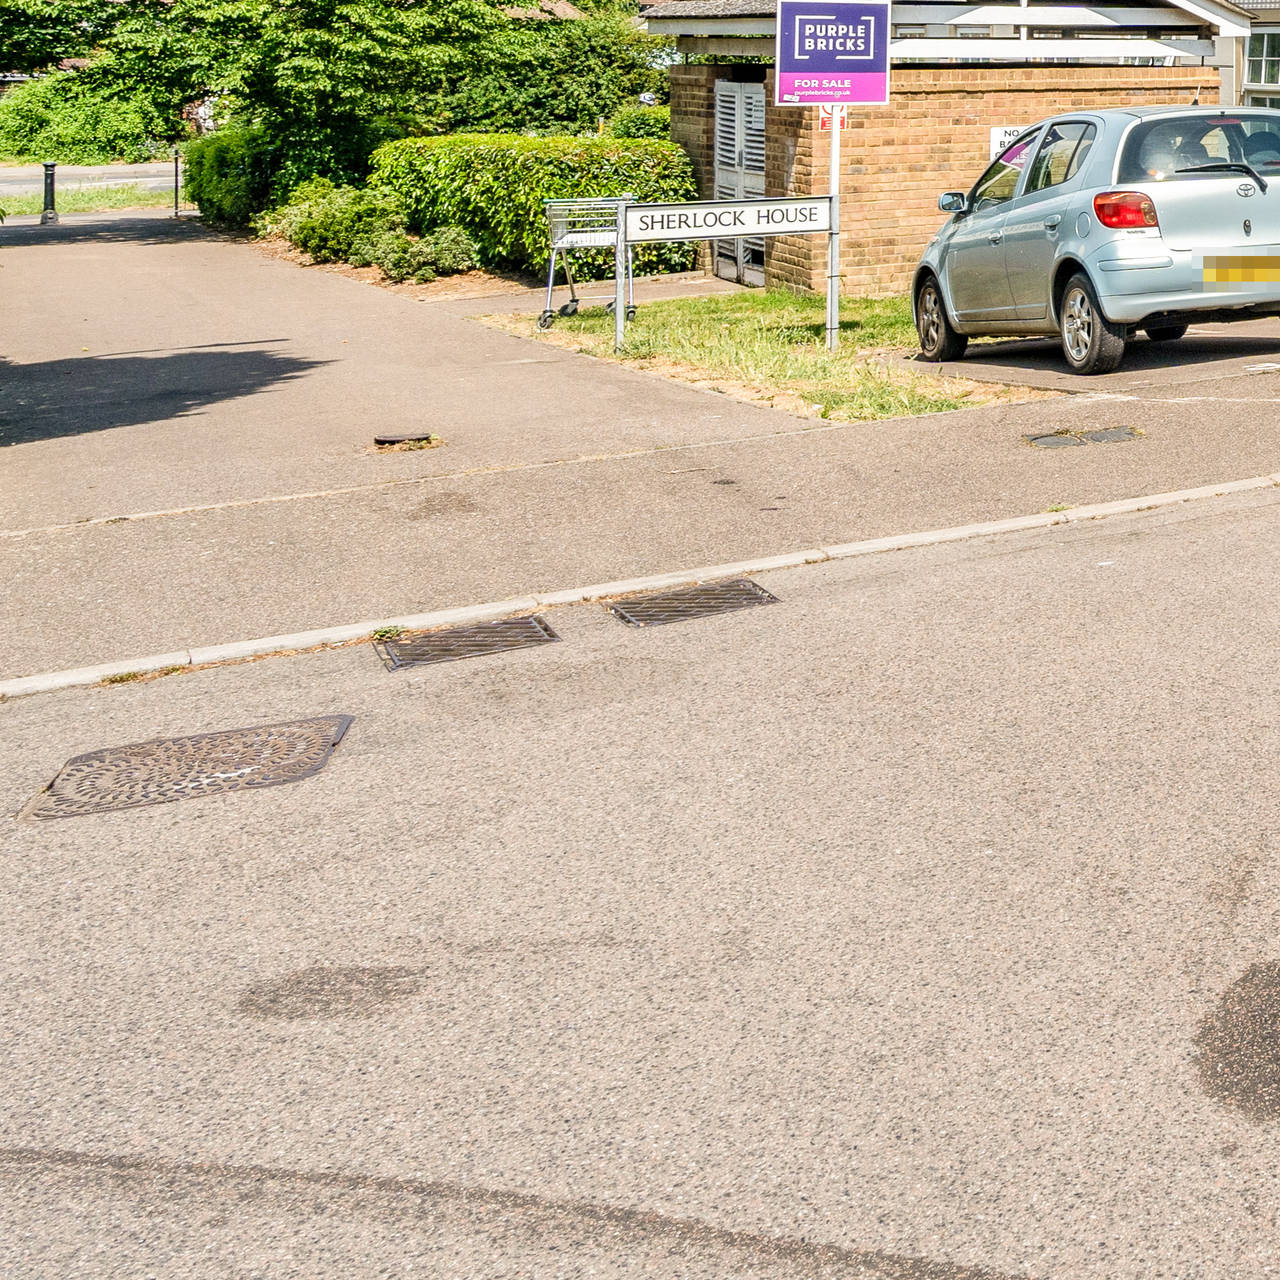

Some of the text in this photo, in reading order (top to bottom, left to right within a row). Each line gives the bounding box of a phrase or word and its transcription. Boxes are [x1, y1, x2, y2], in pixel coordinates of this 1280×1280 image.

[804, 24, 866, 37] PURPLE
[804, 38, 866, 51] BRICKS
[794, 79, 852, 88] FOR SALE
[1004, 129, 1020, 137] NO
[638, 207, 819, 231] SHERLOCK HOUSE
